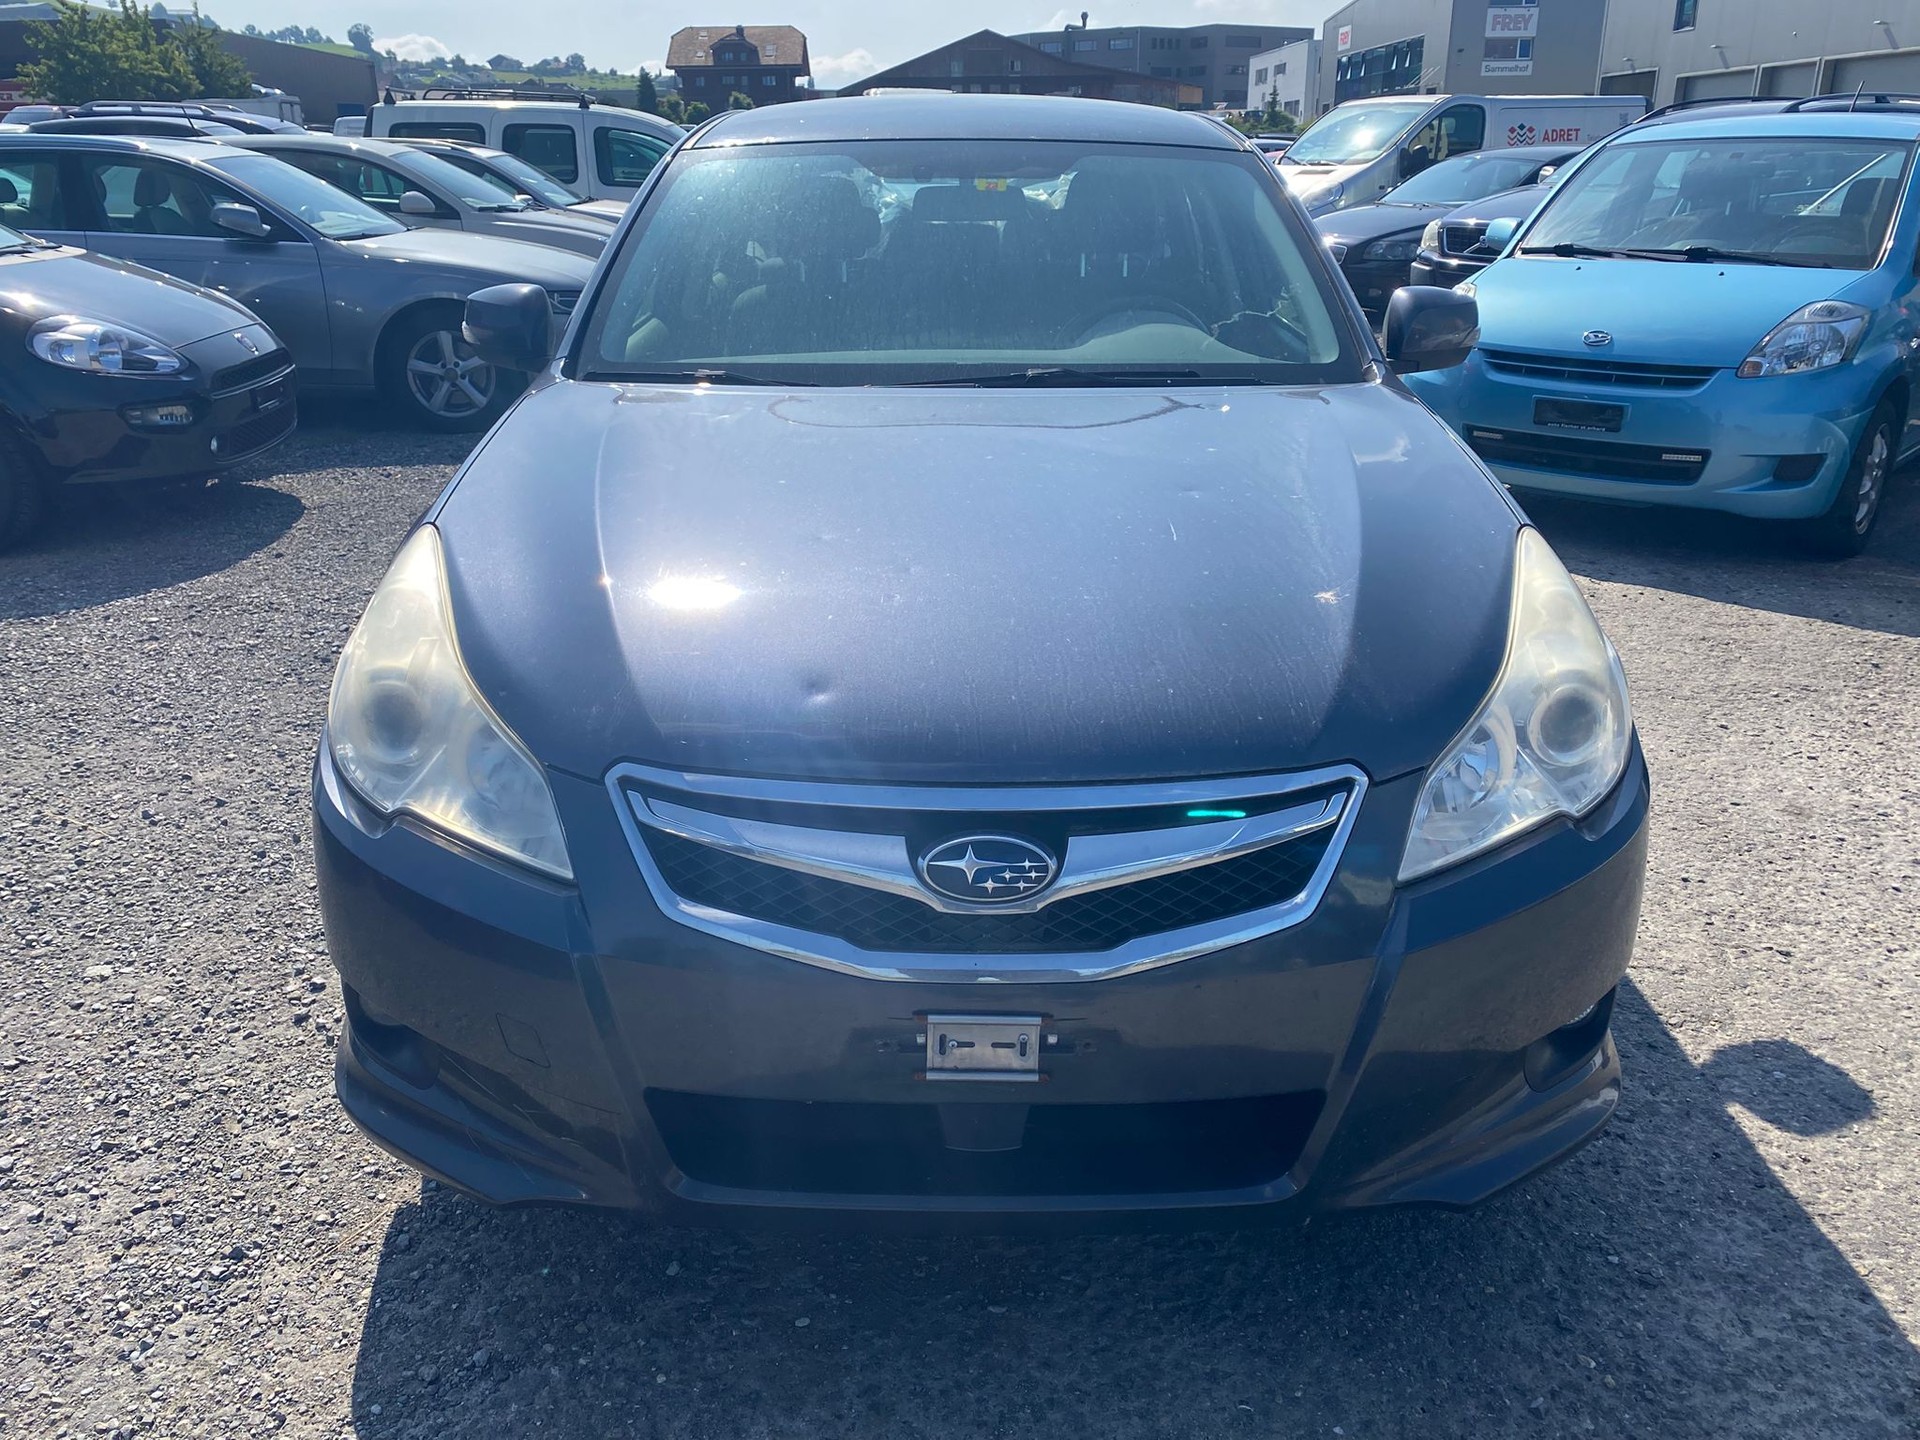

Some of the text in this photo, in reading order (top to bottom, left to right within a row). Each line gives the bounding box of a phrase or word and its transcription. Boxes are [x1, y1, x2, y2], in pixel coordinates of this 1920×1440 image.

[1491, 13, 1534, 31] FREY
[1484, 64, 1529, 73] Sammelhof
[1542, 128, 1581, 143] ADRET
